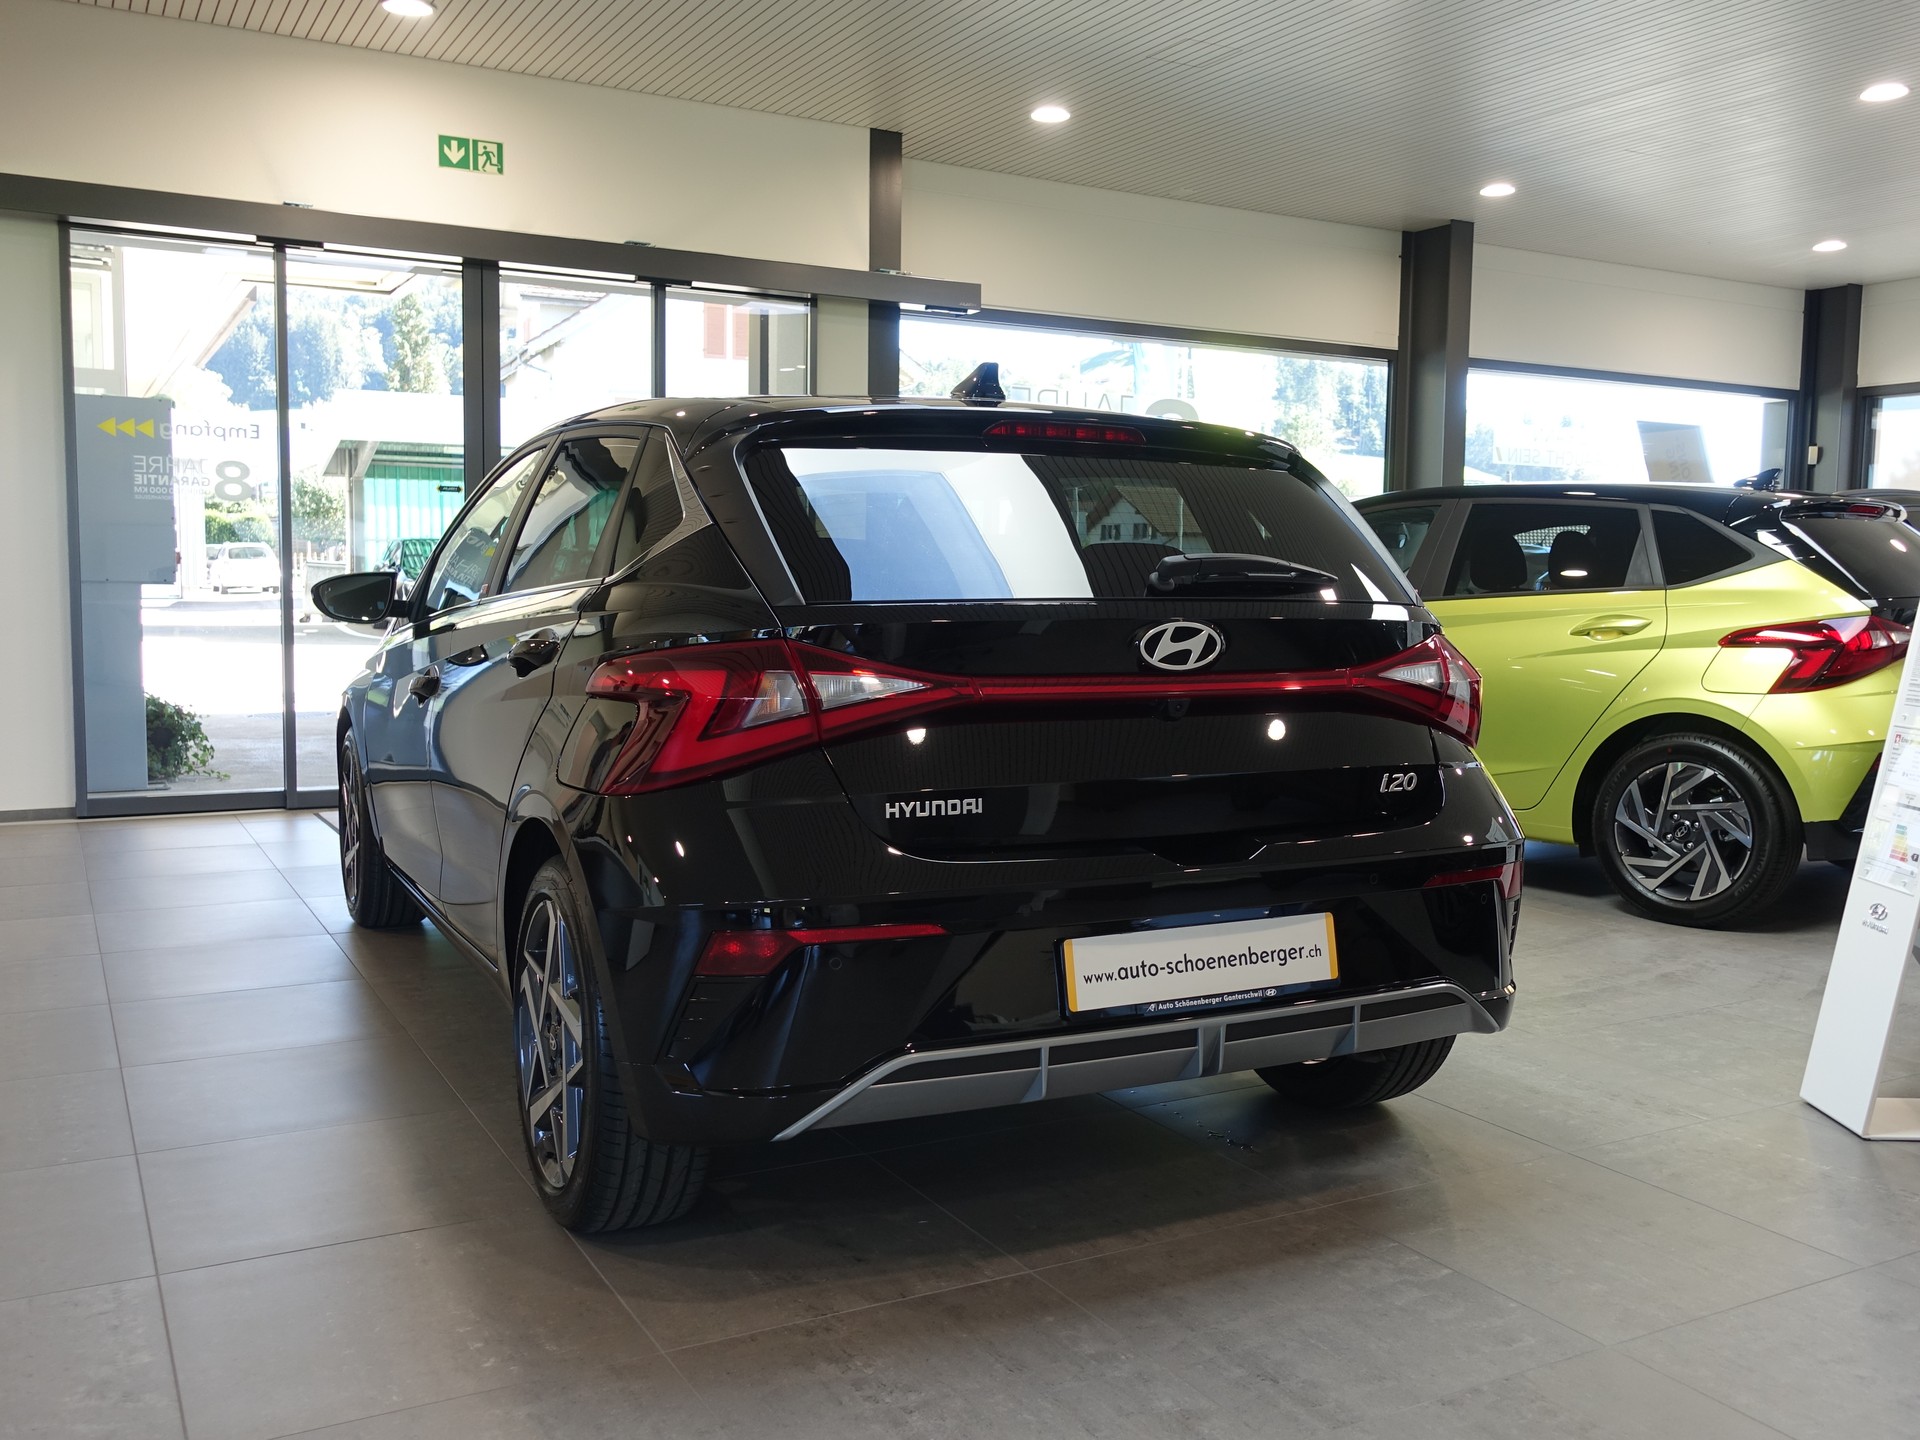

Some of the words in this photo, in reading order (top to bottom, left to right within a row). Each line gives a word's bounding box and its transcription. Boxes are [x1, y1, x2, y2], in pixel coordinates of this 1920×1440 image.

[885, 798, 983, 819] HYUNDAI
[1083, 944, 1322, 984] www.auto-schoenenberger.ch
[1158, 1001, 1174, 1010] Auto
[1174, 996, 1223, 1008] Schönenberger
[1223, 989, 1263, 1001] Ganterschwil
